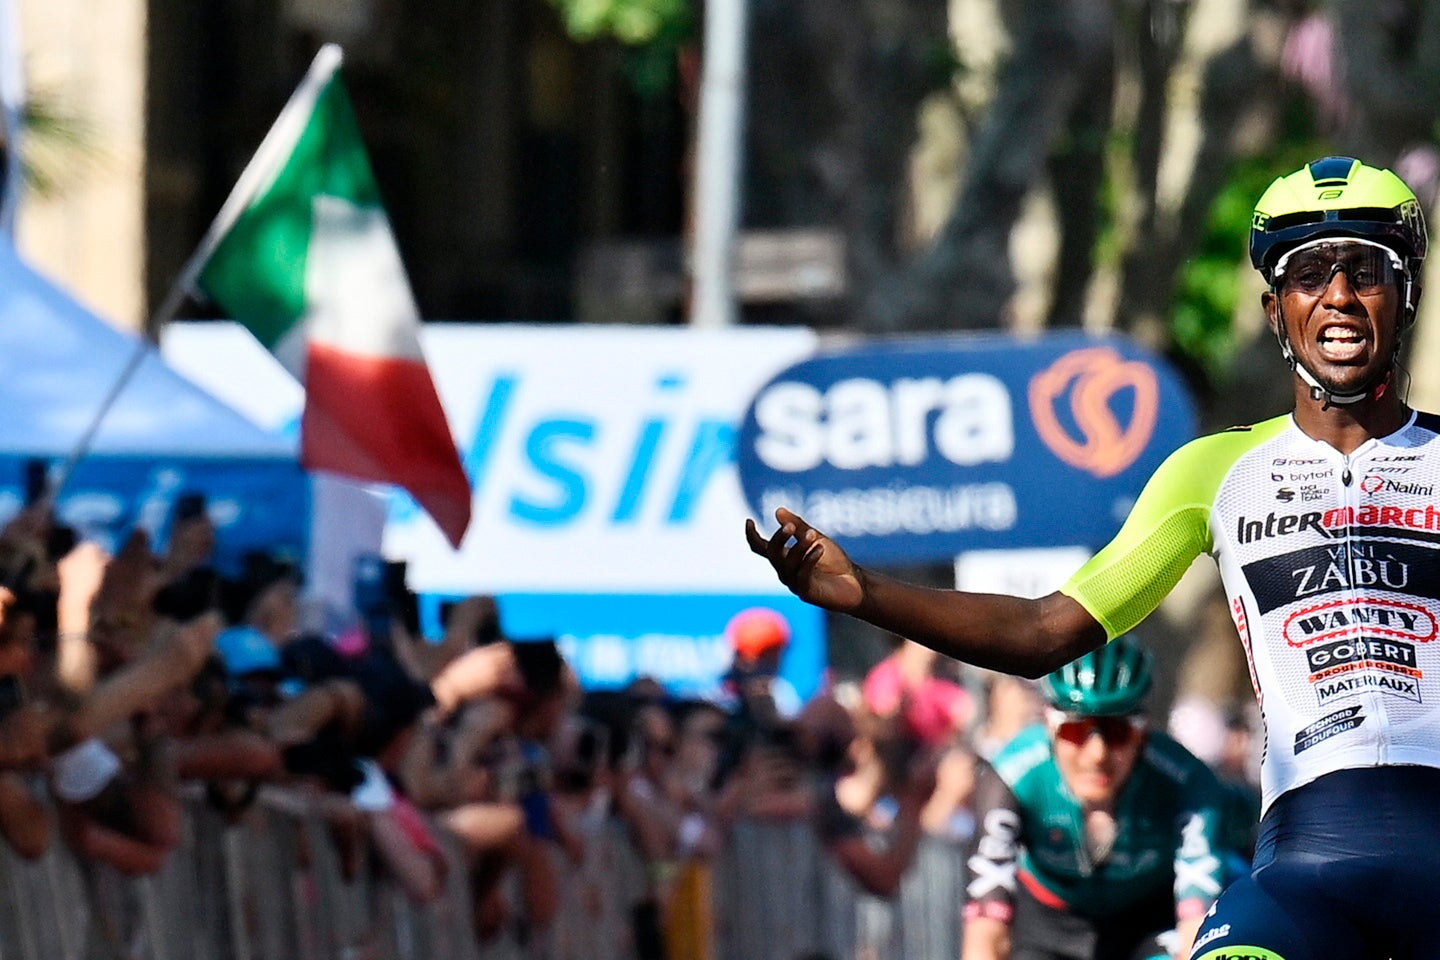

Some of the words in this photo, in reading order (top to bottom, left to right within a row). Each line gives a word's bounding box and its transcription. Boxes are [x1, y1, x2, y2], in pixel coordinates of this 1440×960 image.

[754, 372, 1015, 472] sara
[1290, 468, 1334, 482] bryton
[1385, 480, 1435, 496] Nalini
[1327, 545, 1375, 560] VINI
[1291, 554, 1409, 598] ZABÙ
[1298, 607, 1419, 635] WANTY
[1310, 640, 1412, 666] GOBERT
[1319, 675, 1417, 700] MATERIAUX
